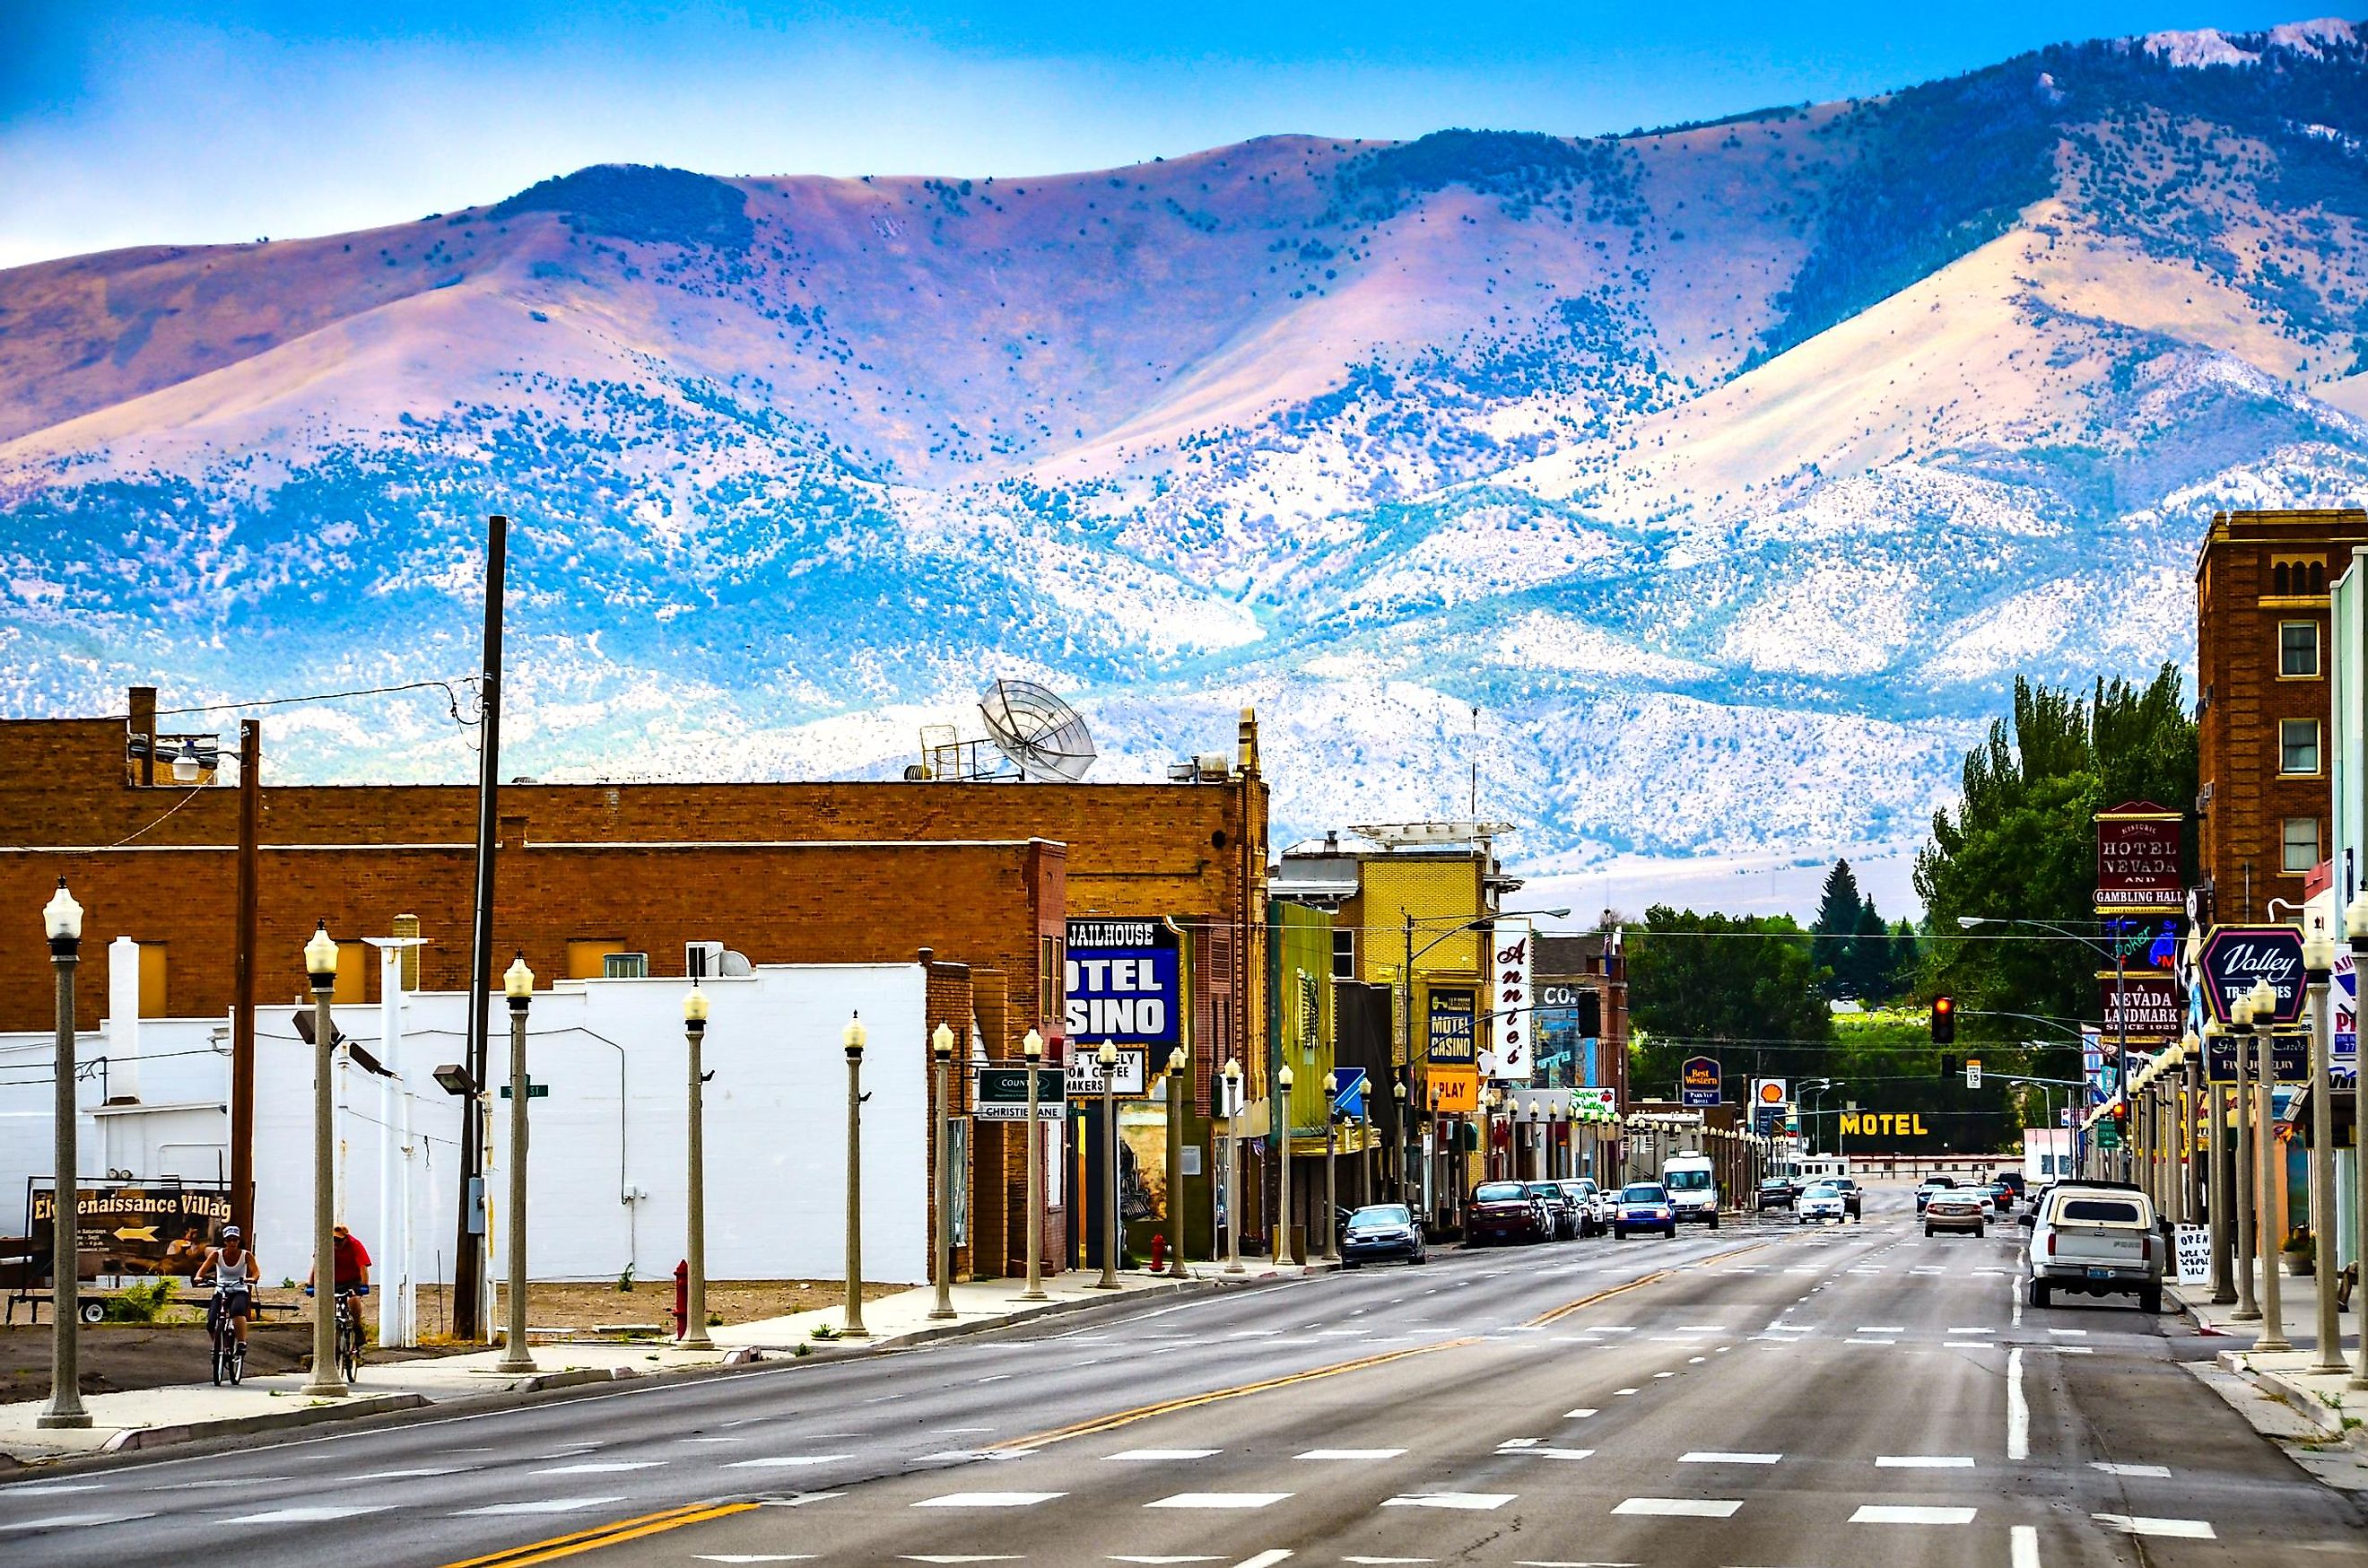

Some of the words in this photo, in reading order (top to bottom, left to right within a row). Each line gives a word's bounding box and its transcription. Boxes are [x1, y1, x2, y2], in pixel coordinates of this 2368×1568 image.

[2121, 824, 2156, 835] HISTORIC
[2102, 841, 2177, 856] HOTEL
[2102, 859, 2177, 873] NEVADA
[2096, 891, 2153, 902] GAMBLING
[2155, 891, 2184, 902] HALL
[1069, 924, 1154, 946] JAILHOUSE
[2224, 944, 2297, 983] Valley
[1066, 959, 1163, 992] OTEL
[1496, 936, 1527, 1065] Annie's
[1543, 987, 1578, 1005] CO.
[2110, 992, 2172, 1006] NEVADA
[1066, 998, 1164, 1034] SINO
[2103, 1008, 2179, 1023] LANDMARK
[1431, 1015, 1470, 1034] MOTEL
[1431, 1037, 1471, 1057] CASINO
[1092, 1067, 1129, 1078] COFEE
[1692, 1068, 1710, 1078] Best
[1969, 1074, 1979, 1082] 15
[1685, 1076, 1718, 1085] Western
[1439, 1082, 1466, 1098] PLAY
[986, 1108, 1029, 1117] CHRISTIE
[1038, 1108, 1058, 1117] ANE
[1840, 1113, 1928, 1136] MOTEL
[78, 1195, 178, 1215] enaissance
[180, 1195, 231, 1223] Villag
[2181, 1233, 2209, 1246] OPEN
